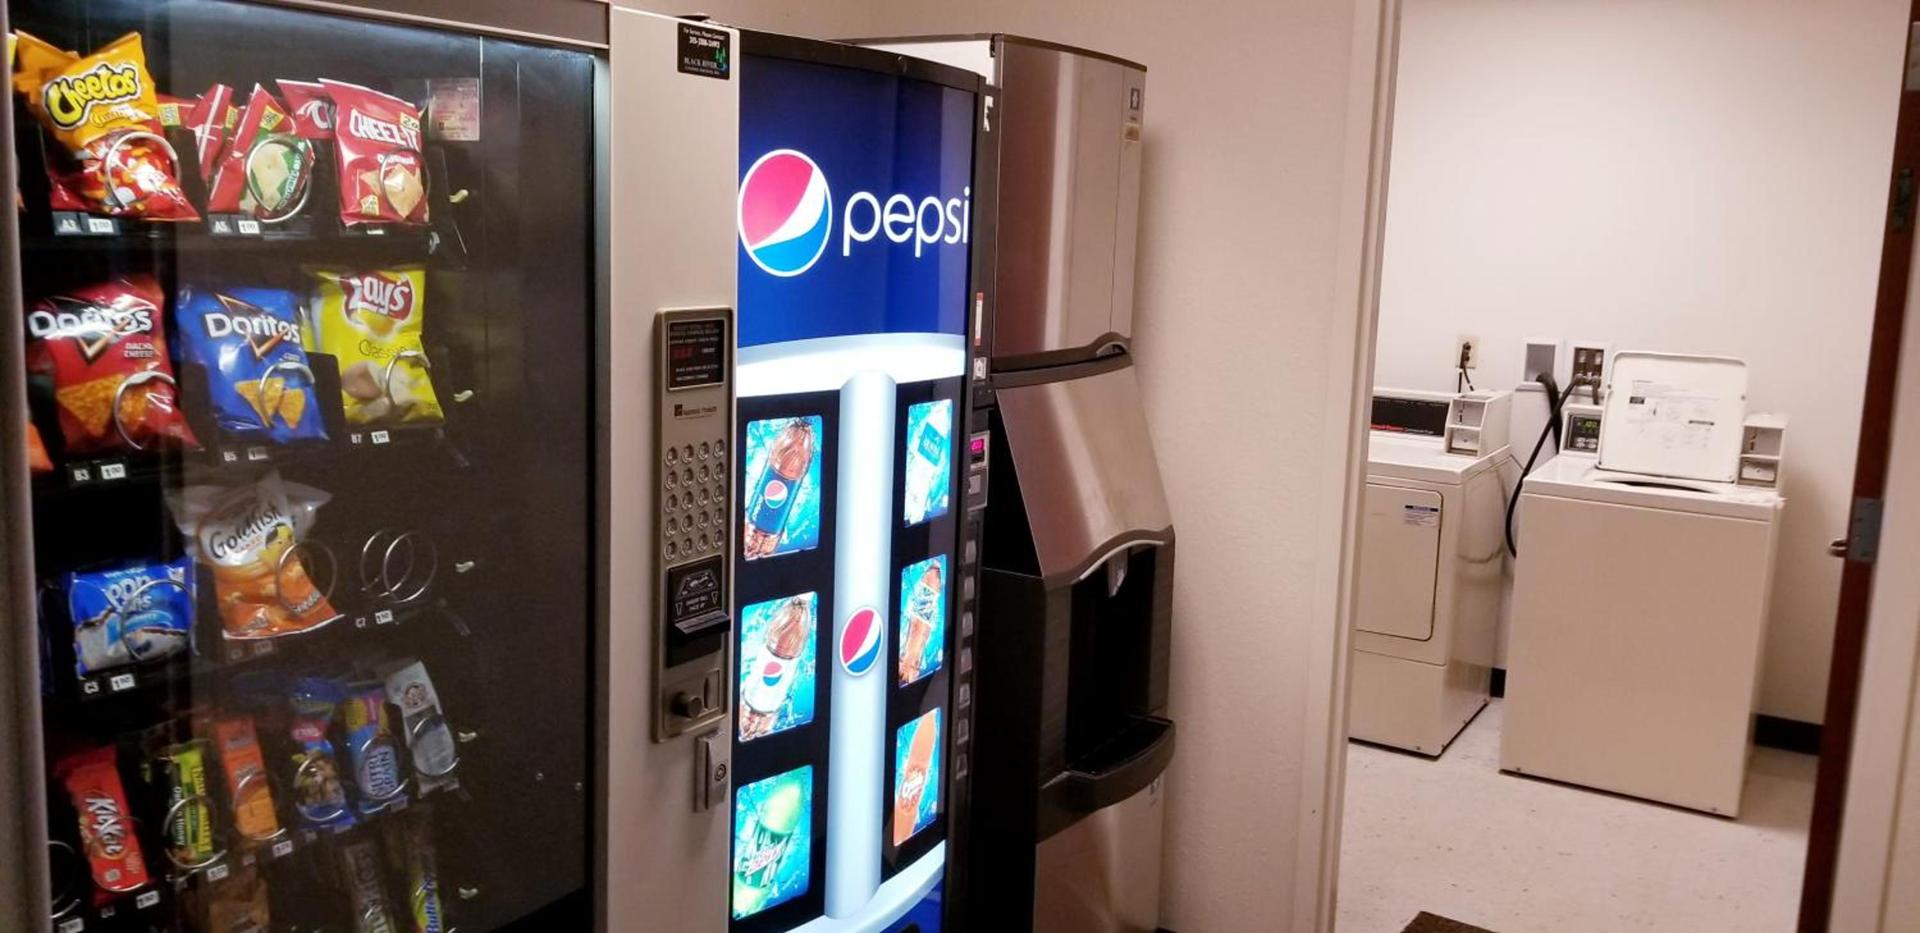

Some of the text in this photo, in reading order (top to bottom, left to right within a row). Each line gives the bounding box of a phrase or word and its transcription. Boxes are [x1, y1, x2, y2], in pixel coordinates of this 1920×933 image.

[46, 63, 137, 127] Cheetos
[842, 186, 970, 258] pepsi
[27, 307, 153, 338] Doritos
[204, 312, 301, 344] Doritos
[209, 503, 282, 559] Goldfish
